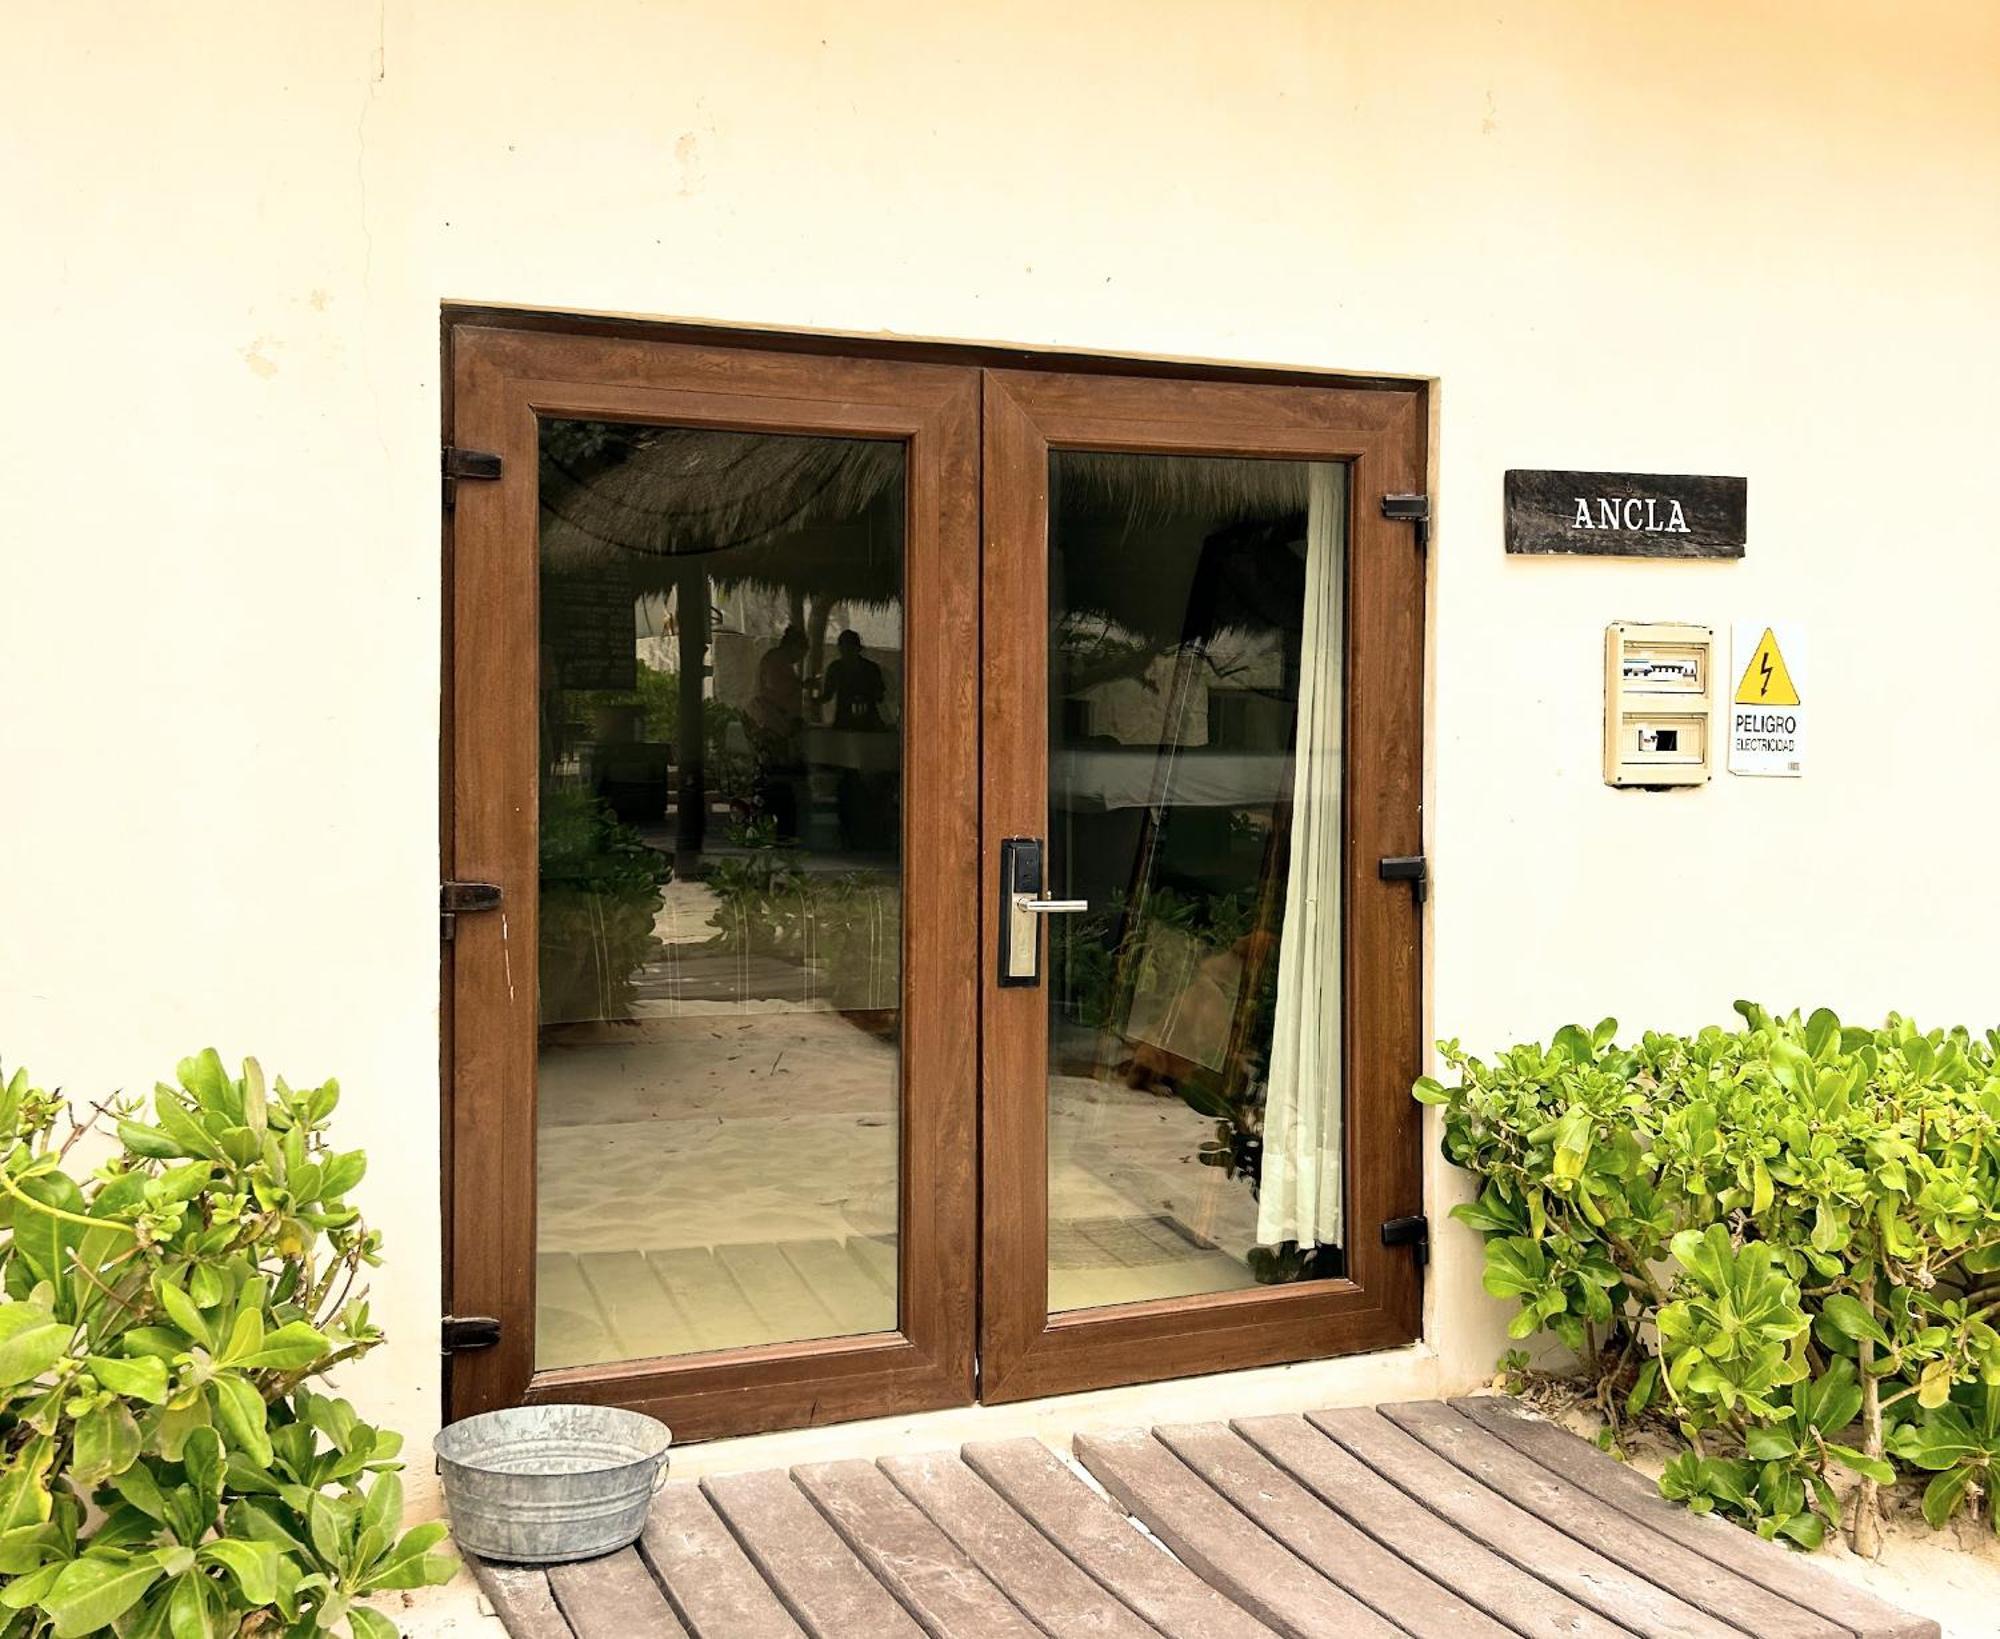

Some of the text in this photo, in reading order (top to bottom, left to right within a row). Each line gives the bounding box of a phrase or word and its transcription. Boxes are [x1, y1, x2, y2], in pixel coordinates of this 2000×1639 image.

[1571, 497, 1692, 533] ANCLA
[1735, 714, 1797, 734] PELIGRO
[1735, 738, 1795, 752] ELECTRICIDAD
